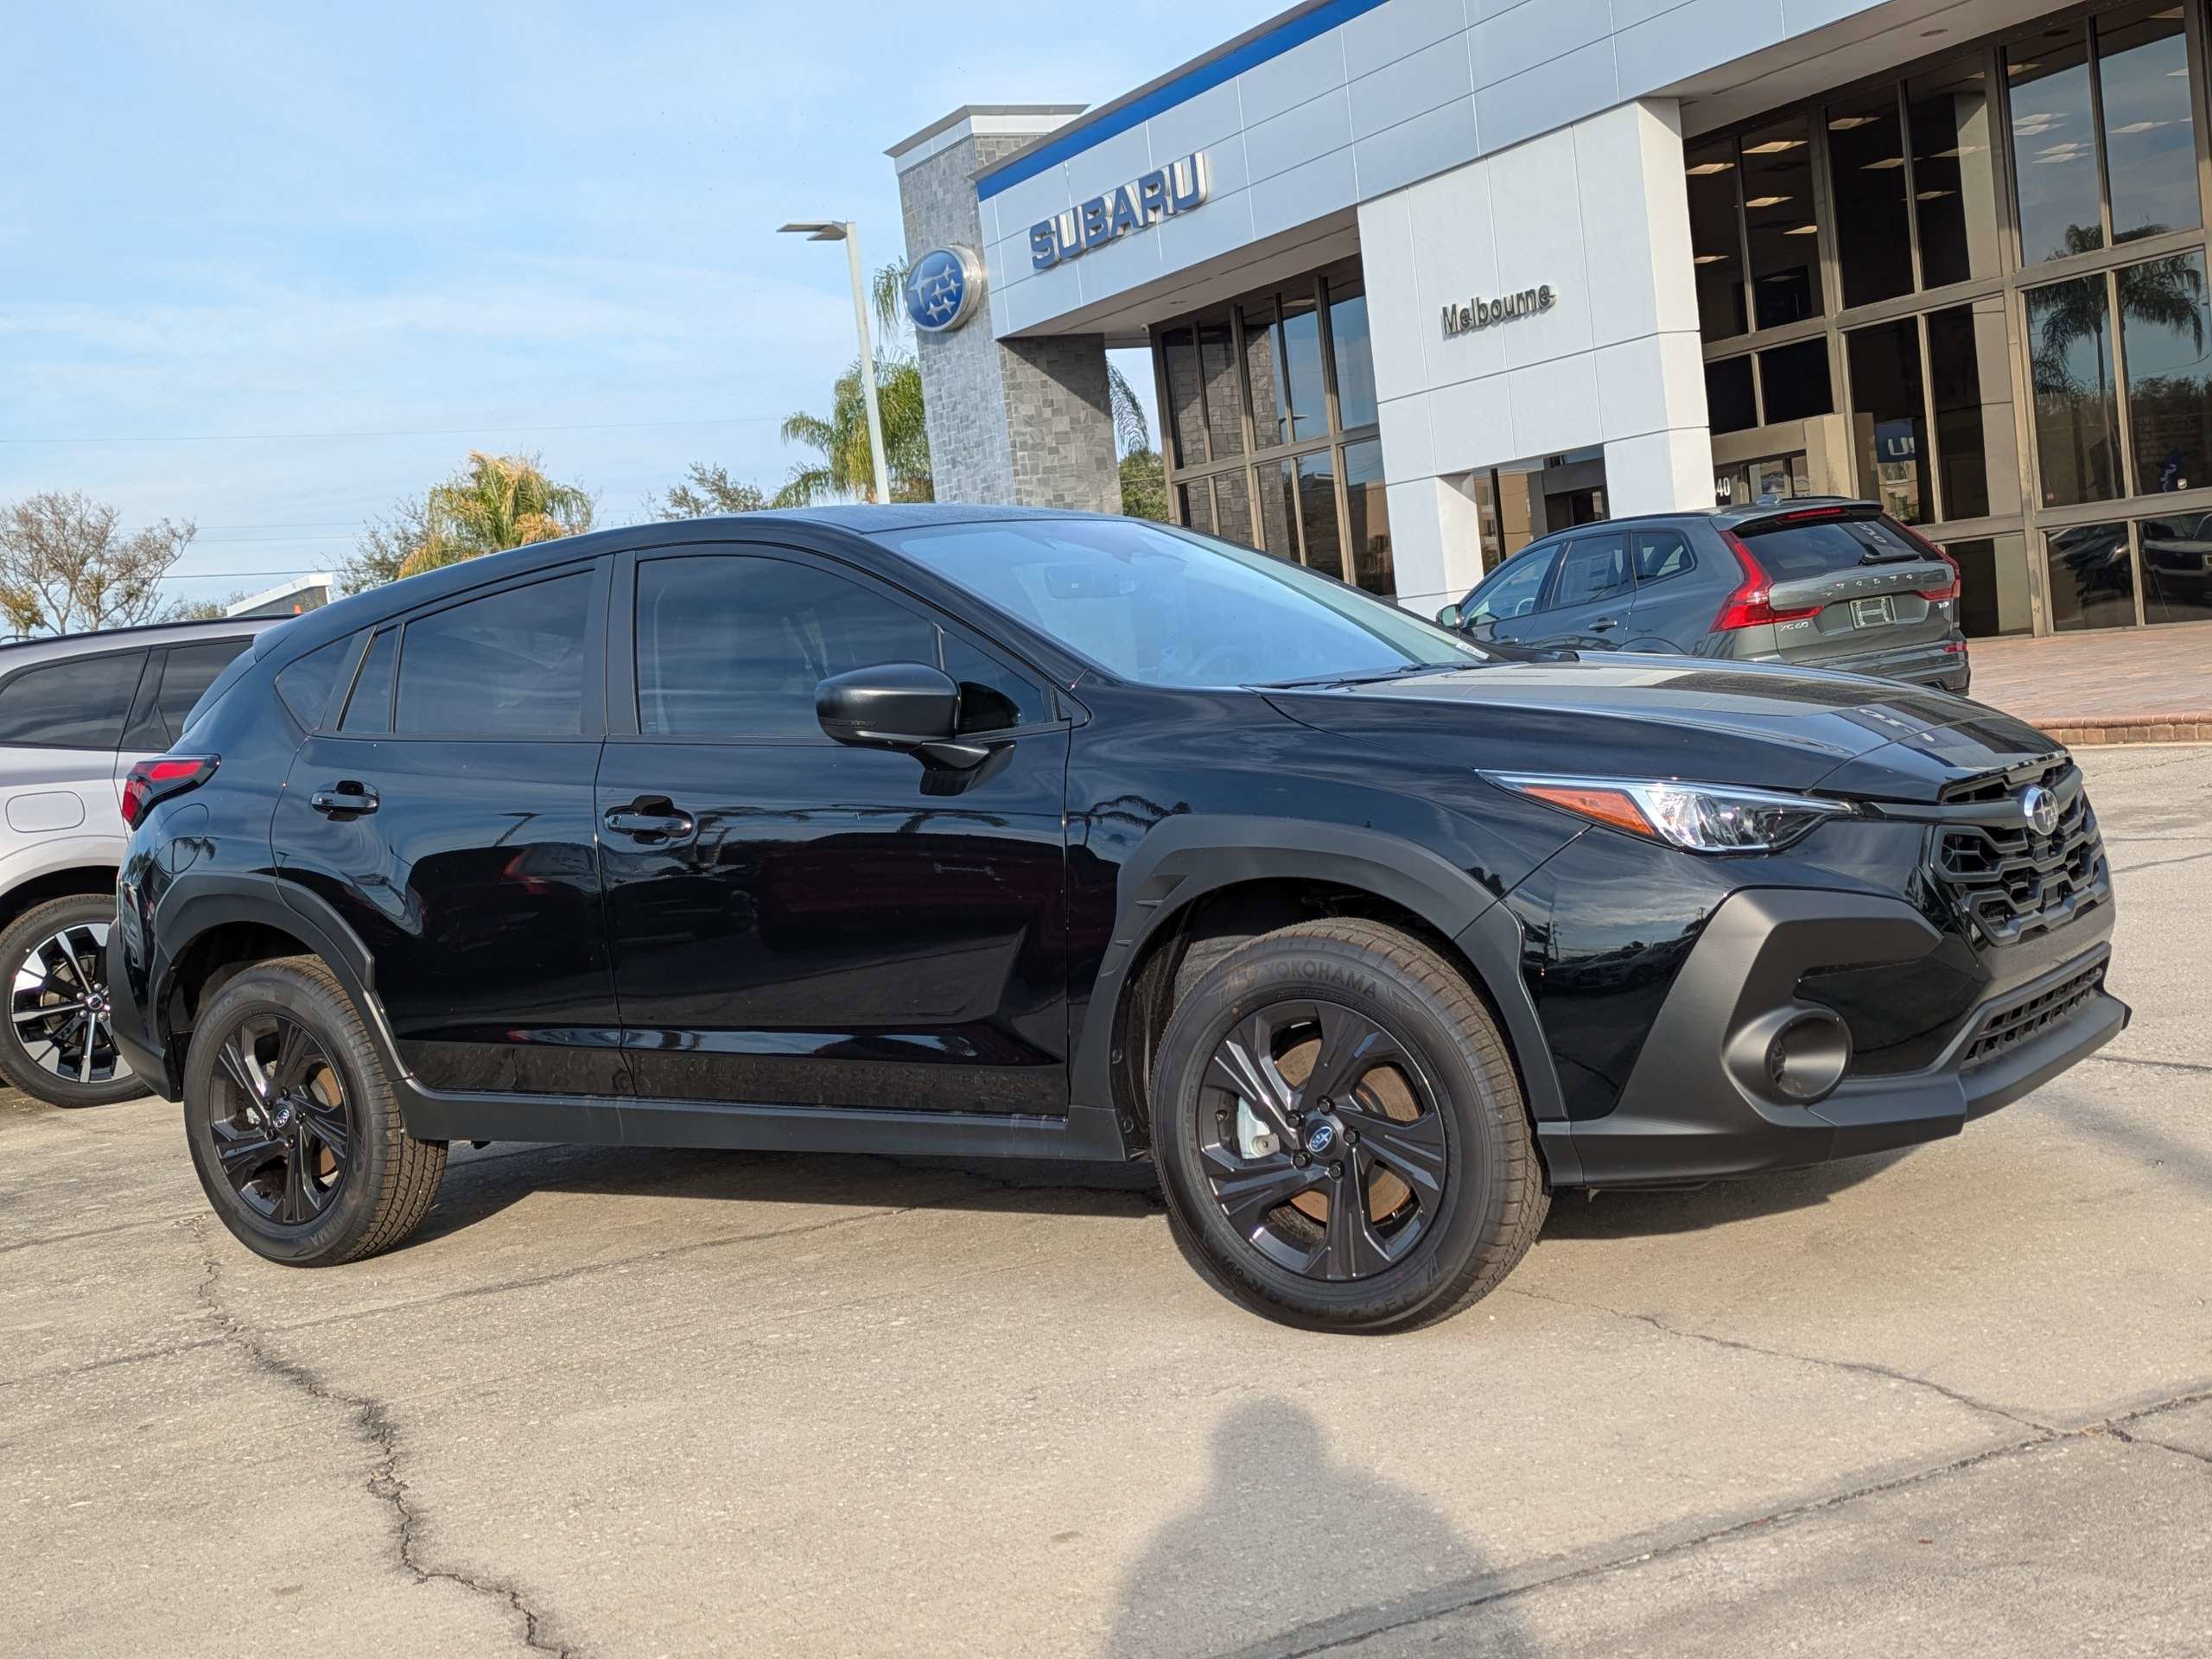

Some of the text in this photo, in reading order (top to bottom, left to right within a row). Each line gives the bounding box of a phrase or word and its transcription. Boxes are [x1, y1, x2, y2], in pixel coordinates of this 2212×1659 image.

[1029, 152, 1206, 270] SUBARU
[1442, 284, 1554, 335] Melbourne
[1714, 477, 1731, 498] 40
[1264, 960, 1376, 999] YOKOHAMA
